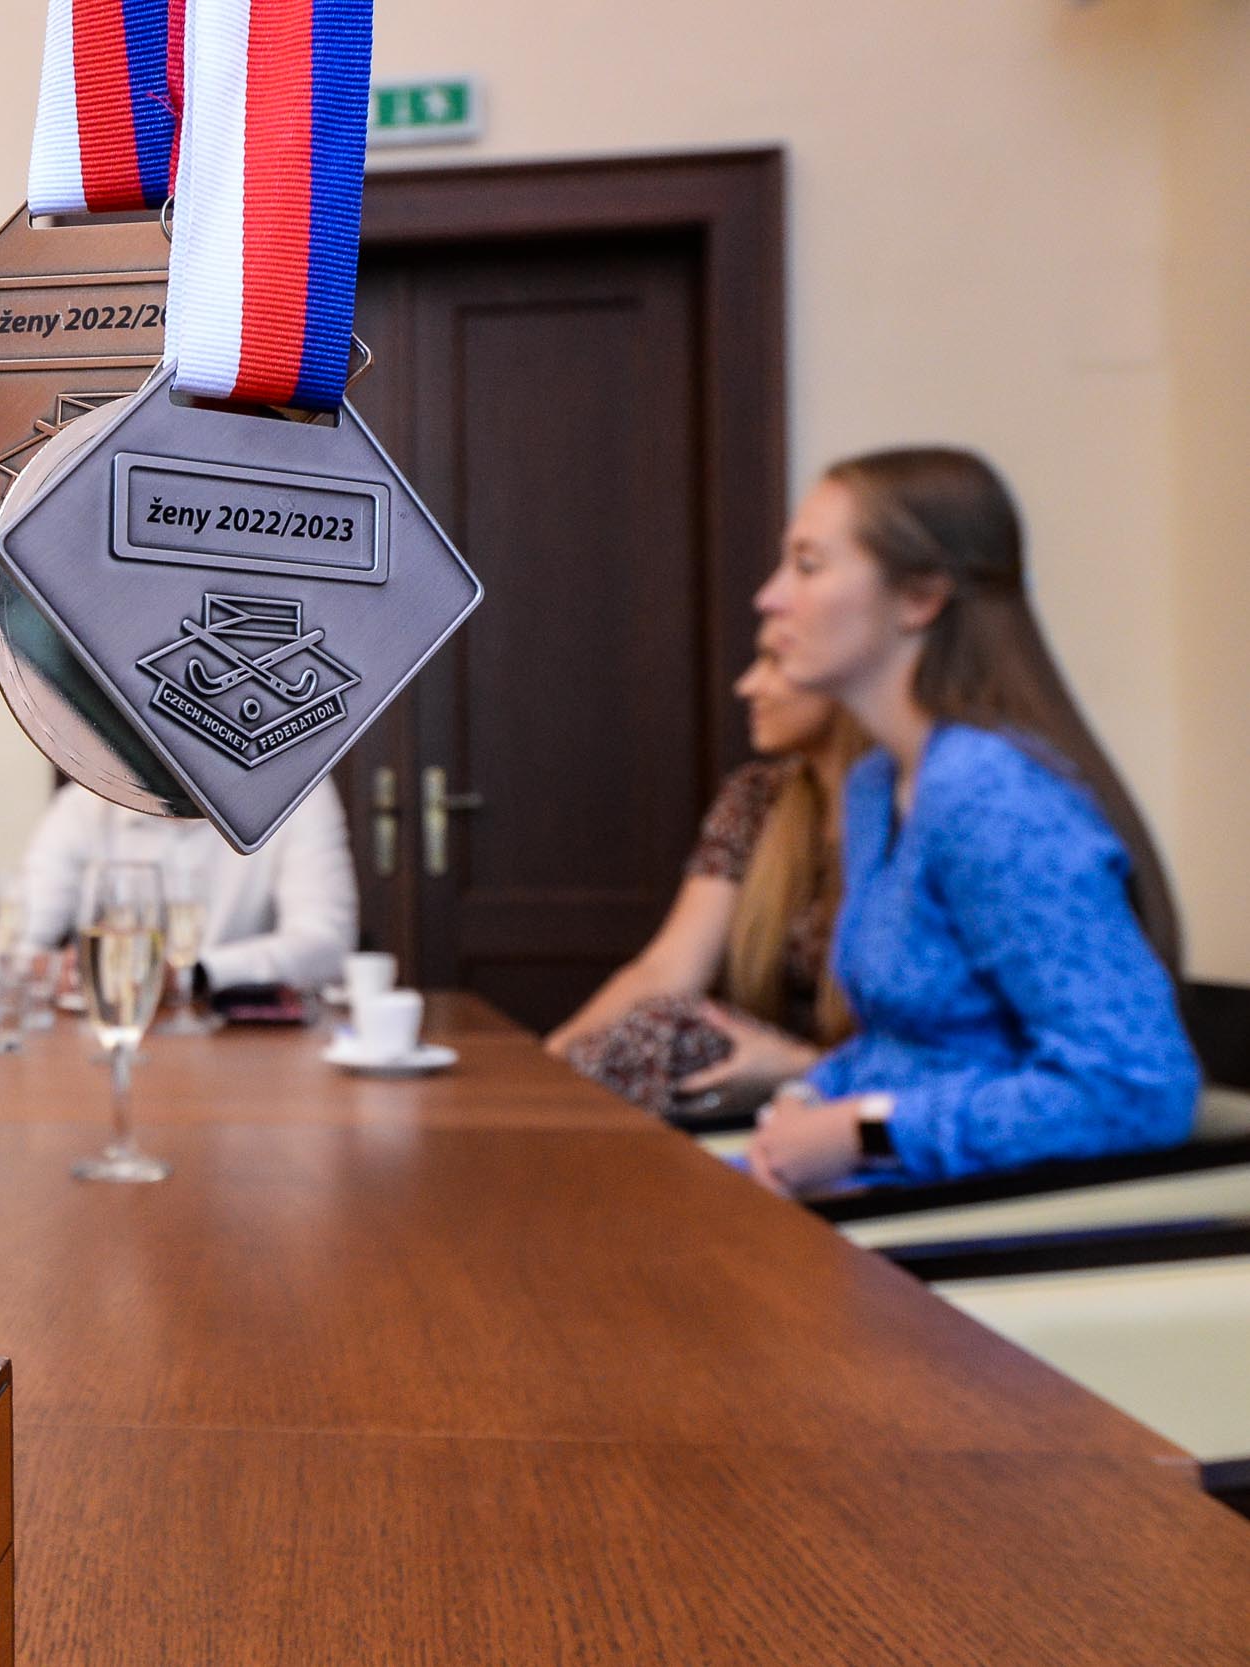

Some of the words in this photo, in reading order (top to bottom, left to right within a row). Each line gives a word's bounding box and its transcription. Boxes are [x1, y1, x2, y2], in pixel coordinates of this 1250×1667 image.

[147, 497, 211, 534] ženy
[216, 505, 354, 541] 2022/2023
[162, 689, 201, 719] CZECH
[202, 714, 249, 751] HOCKEY
[259, 702, 335, 750] FEDERATION
